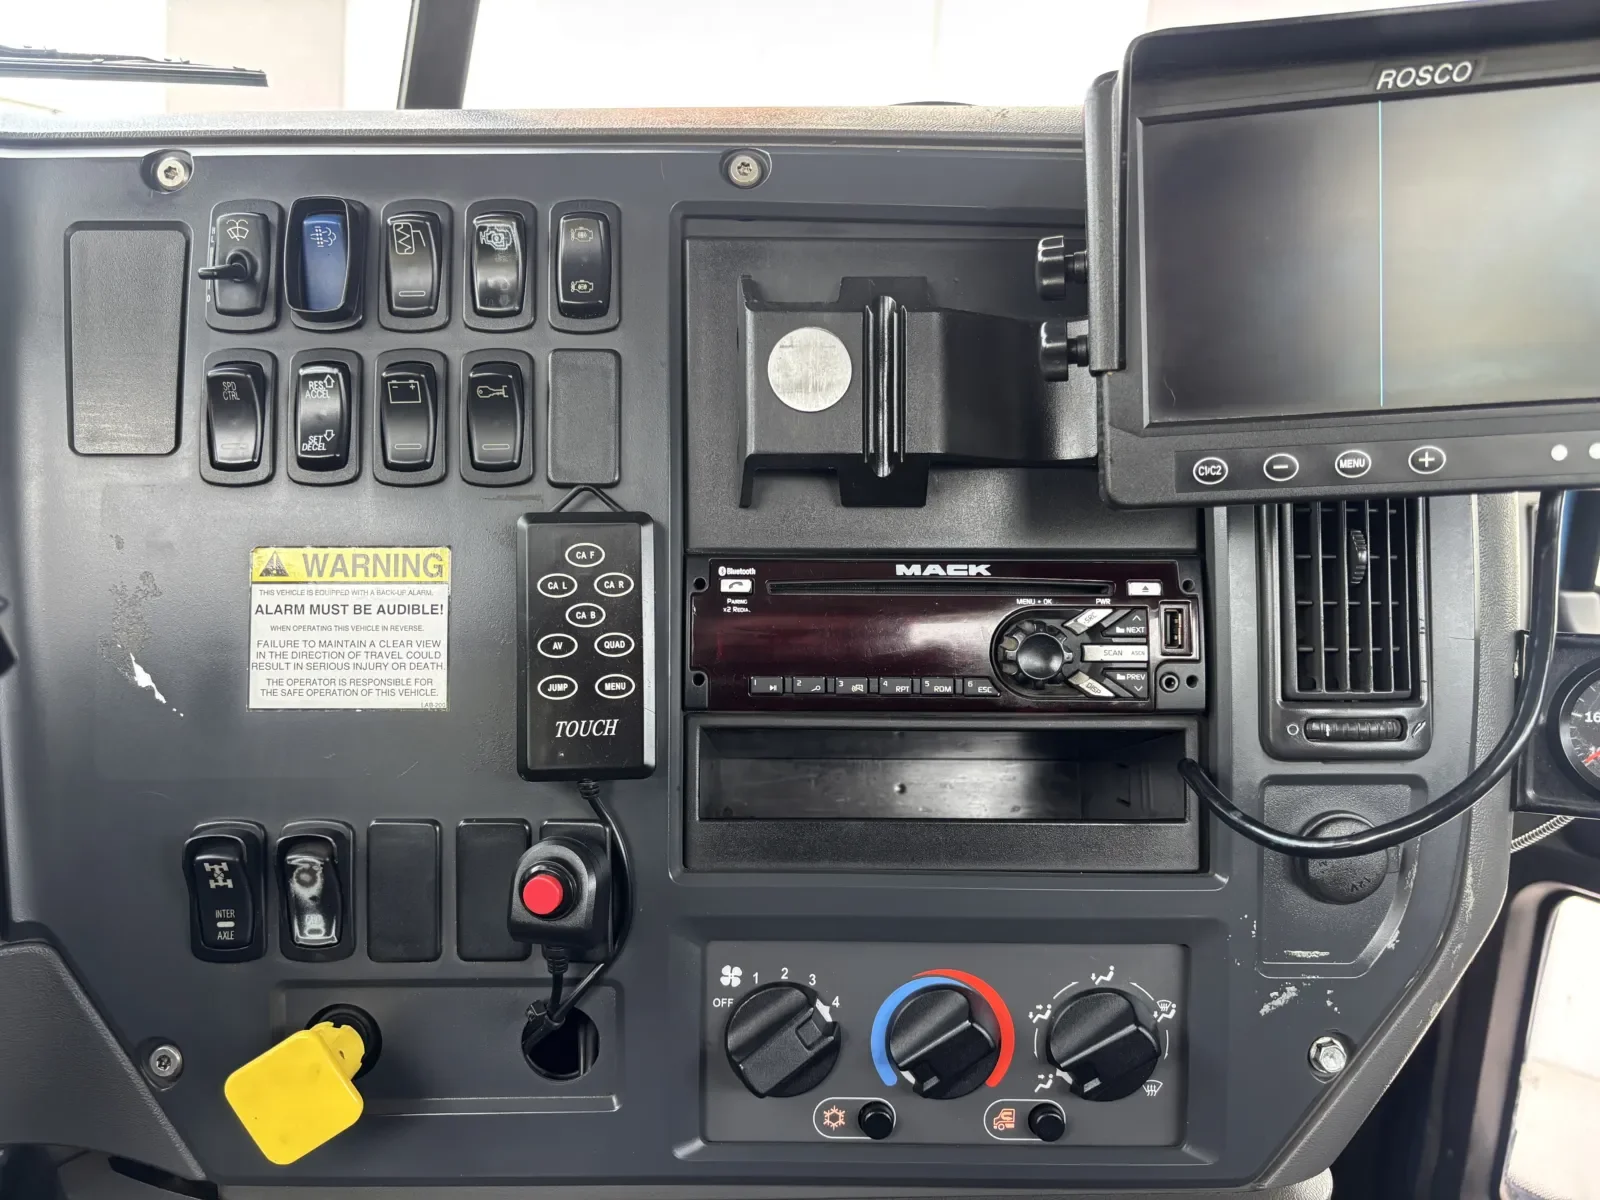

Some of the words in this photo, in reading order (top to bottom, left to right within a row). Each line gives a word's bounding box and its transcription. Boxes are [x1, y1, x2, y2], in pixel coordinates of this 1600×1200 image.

[1376, 61, 1472, 90] ROSCO
[222, 381, 237, 391] SPD
[222, 390, 240, 400] CTRL
[305, 389, 331, 399] ACCEL
[308, 435, 323, 445] SET
[302, 443, 327, 451] DECEL
[1339, 458, 1366, 469] MENU
[575, 551, 587, 560] CA
[589, 551, 595, 559] F
[302, 553, 443, 578] WARNING
[895, 563, 992, 576] MACK
[726, 567, 757, 576] Bluetooth
[547, 581, 559, 590] CA
[562, 581, 568, 589] L
[603, 580, 615, 589] CA
[618, 580, 625, 589] R
[254, 604, 305, 615] ALARM
[309, 604, 349, 615] MUST
[353, 604, 372, 615] BE
[376, 604, 444, 615] AUDIBLE!
[575, 611, 587, 620] CA
[590, 611, 596, 619] B
[1084, 611, 1098, 624] SRC
[256, 639, 300, 648] FAILURE
[302, 639, 316, 648] TO
[318, 639, 366, 648] MAINTAIN
[369, 639, 376, 648] A
[379, 639, 413, 648] CLEAR
[416, 639, 442, 648] VIEW
[552, 641, 563, 650] AV
[603, 640, 626, 649] QUAD
[256, 651, 266, 659] IN
[268, 651, 288, 659] THE
[291, 651, 345, 659] DIRECTION
[347, 651, 361, 659] OF
[364, 651, 403, 659] TRAVEL
[406, 651, 441, 659] COULD
[1103, 649, 1123, 657] SCAN
[251, 662, 291, 671] RESULT
[293, 662, 303, 671] IN
[305, 662, 350, 671] SERIOUS
[353, 662, 389, 671] INJURY
[391, 662, 406, 671] OR
[409, 662, 446, 671] DEATH.
[266, 678, 284, 686] THE
[286, 678, 336, 686] OPERATOR
[338, 678, 347, 686] IS
[349, 678, 412, 686] RESPONSIBLE
[414, 678, 433, 686] FOR
[604, 682, 627, 691] MENU
[967, 680, 973, 688] 6
[547, 683, 569, 692] JUMP
[895, 685, 910, 693] RPT
[933, 685, 952, 693] RDM
[1085, 682, 1102, 694] DISP
[260, 688, 278, 697] THE
[280, 688, 304, 697] SAFE
[306, 688, 358, 697] OPERATION
[360, 688, 373, 697] OF
[375, 688, 396, 697] THIS
[398, 688, 439, 697] VEHICLE.
[554, 719, 619, 738] TOUCH
[215, 909, 235, 918] INTER
[217, 931, 235, 940] AXLE
[752, 971, 759, 984] 1
[780, 967, 789, 980] 2
[808, 973, 817, 986] 3
[712, 998, 734, 1008] OFF
[831, 996, 840, 1008] 4
